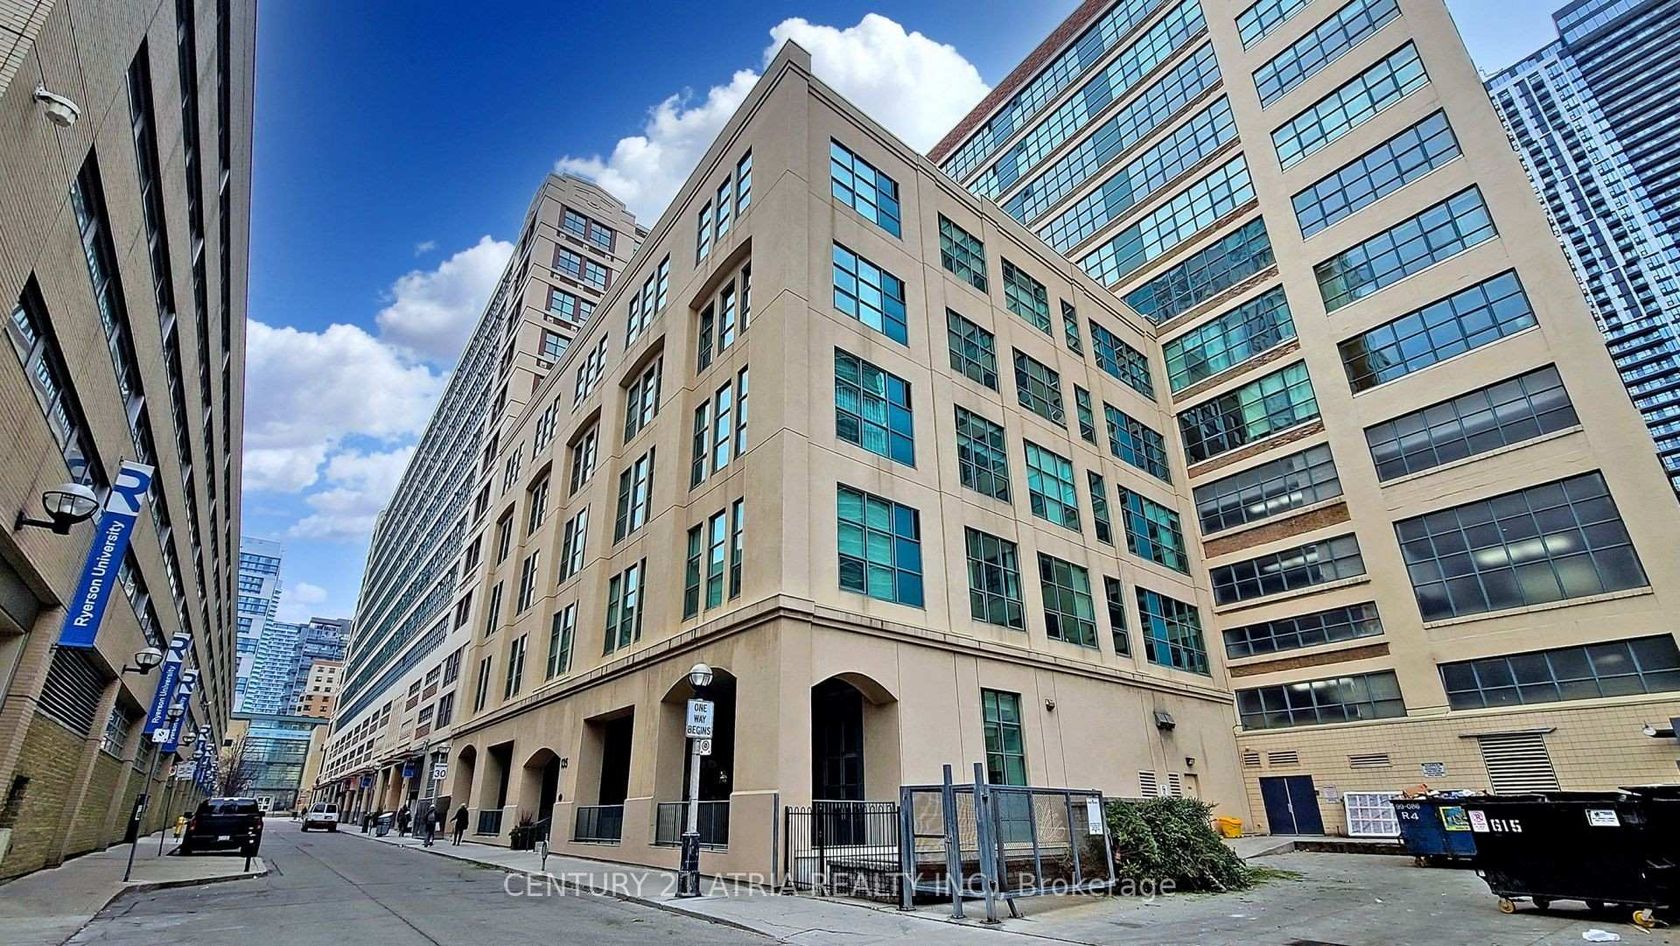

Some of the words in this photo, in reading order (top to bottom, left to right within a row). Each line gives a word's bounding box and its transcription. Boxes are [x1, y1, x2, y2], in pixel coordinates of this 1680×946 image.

[74, 580, 102, 627] Ryerson
[97, 520, 125, 577] University
[152, 694, 165, 724] Ryerson
[160, 665, 176, 697] University
[694, 703, 708, 713] ONE
[693, 714, 707, 723] WAY
[687, 725, 711, 736] BEGINS
[434, 769, 446, 778] 30
[1401, 811, 1419, 820] R4
[1490, 819, 1523, 833] G15
